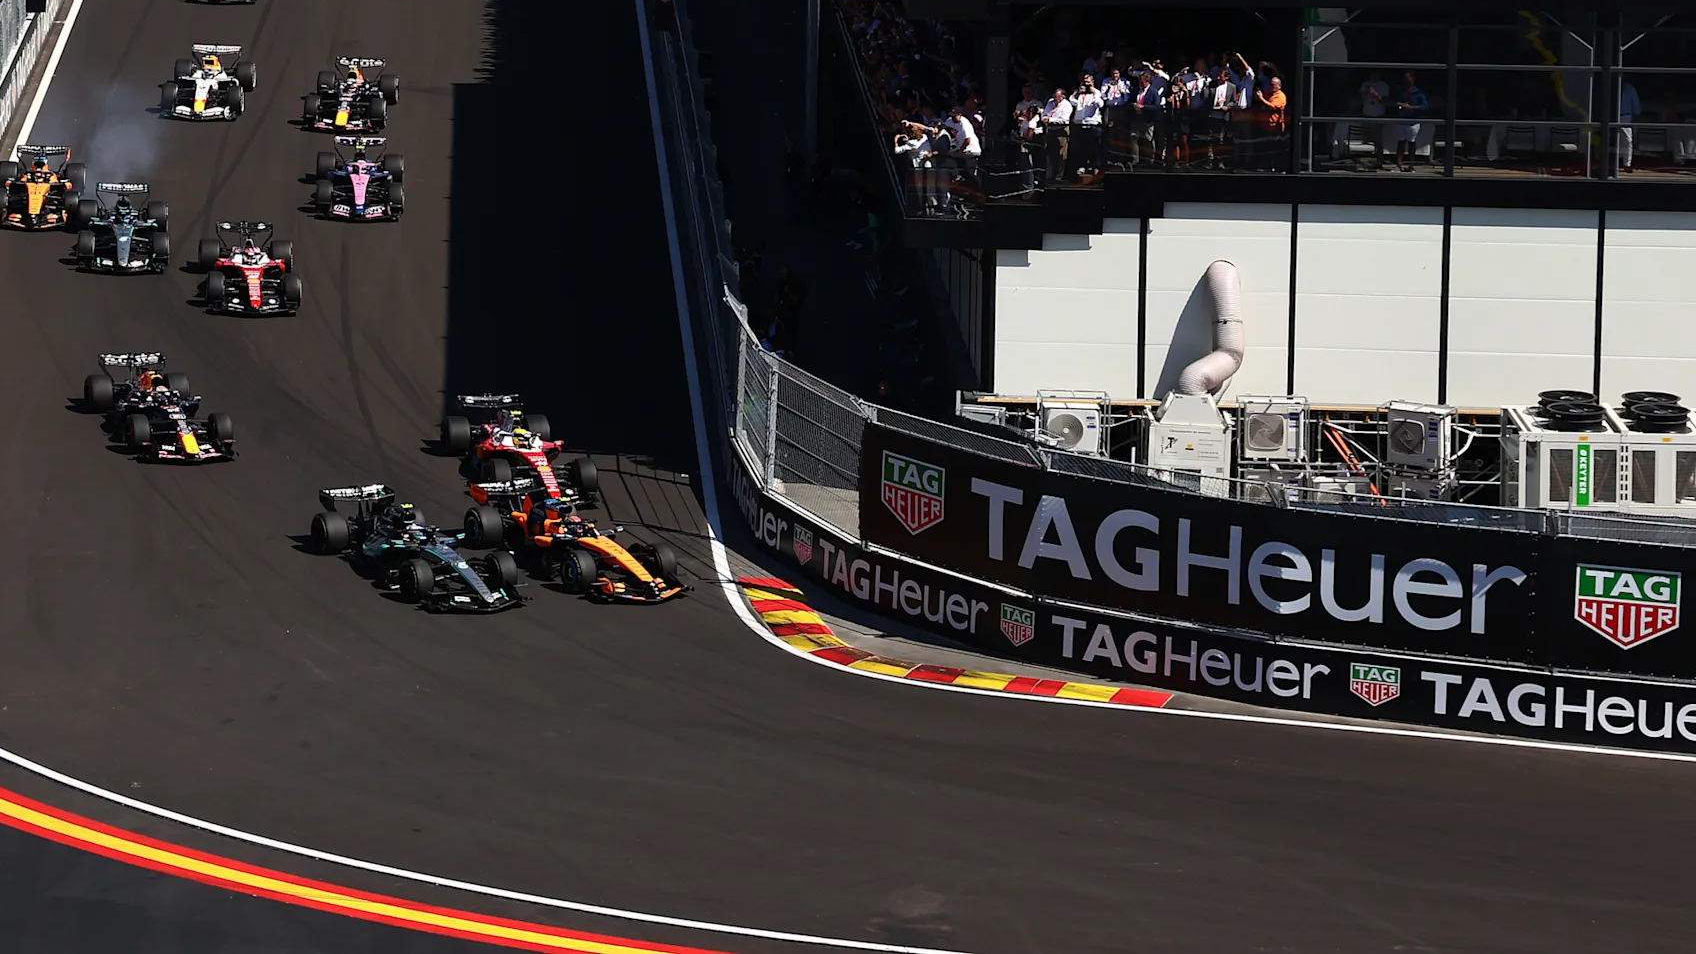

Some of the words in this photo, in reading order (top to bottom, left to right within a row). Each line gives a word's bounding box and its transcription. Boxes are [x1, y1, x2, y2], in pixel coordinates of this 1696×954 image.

[102, 183, 144, 191] PETRONAS
[888, 457, 939, 494] TAG
[1579, 456, 1587, 495] KEYTER
[731, 459, 788, 551] TAGHeuer
[885, 486, 940, 529] HEUER
[795, 526, 812, 543] TAG
[971, 477, 1527, 634] TAGHeuer
[819, 538, 989, 634] TAGHeuer
[1585, 569, 1671, 601] TAG
[1003, 621, 1034, 644] HEUER
[1004, 608, 1033, 624] TAG
[1581, 599, 1673, 643] HEUER
[1052, 615, 1330, 699] TAGHeuer
[1355, 664, 1396, 682] TAG
[1352, 680, 1398, 704] HEUER
[1421, 671, 1696, 741] TAGHeue
